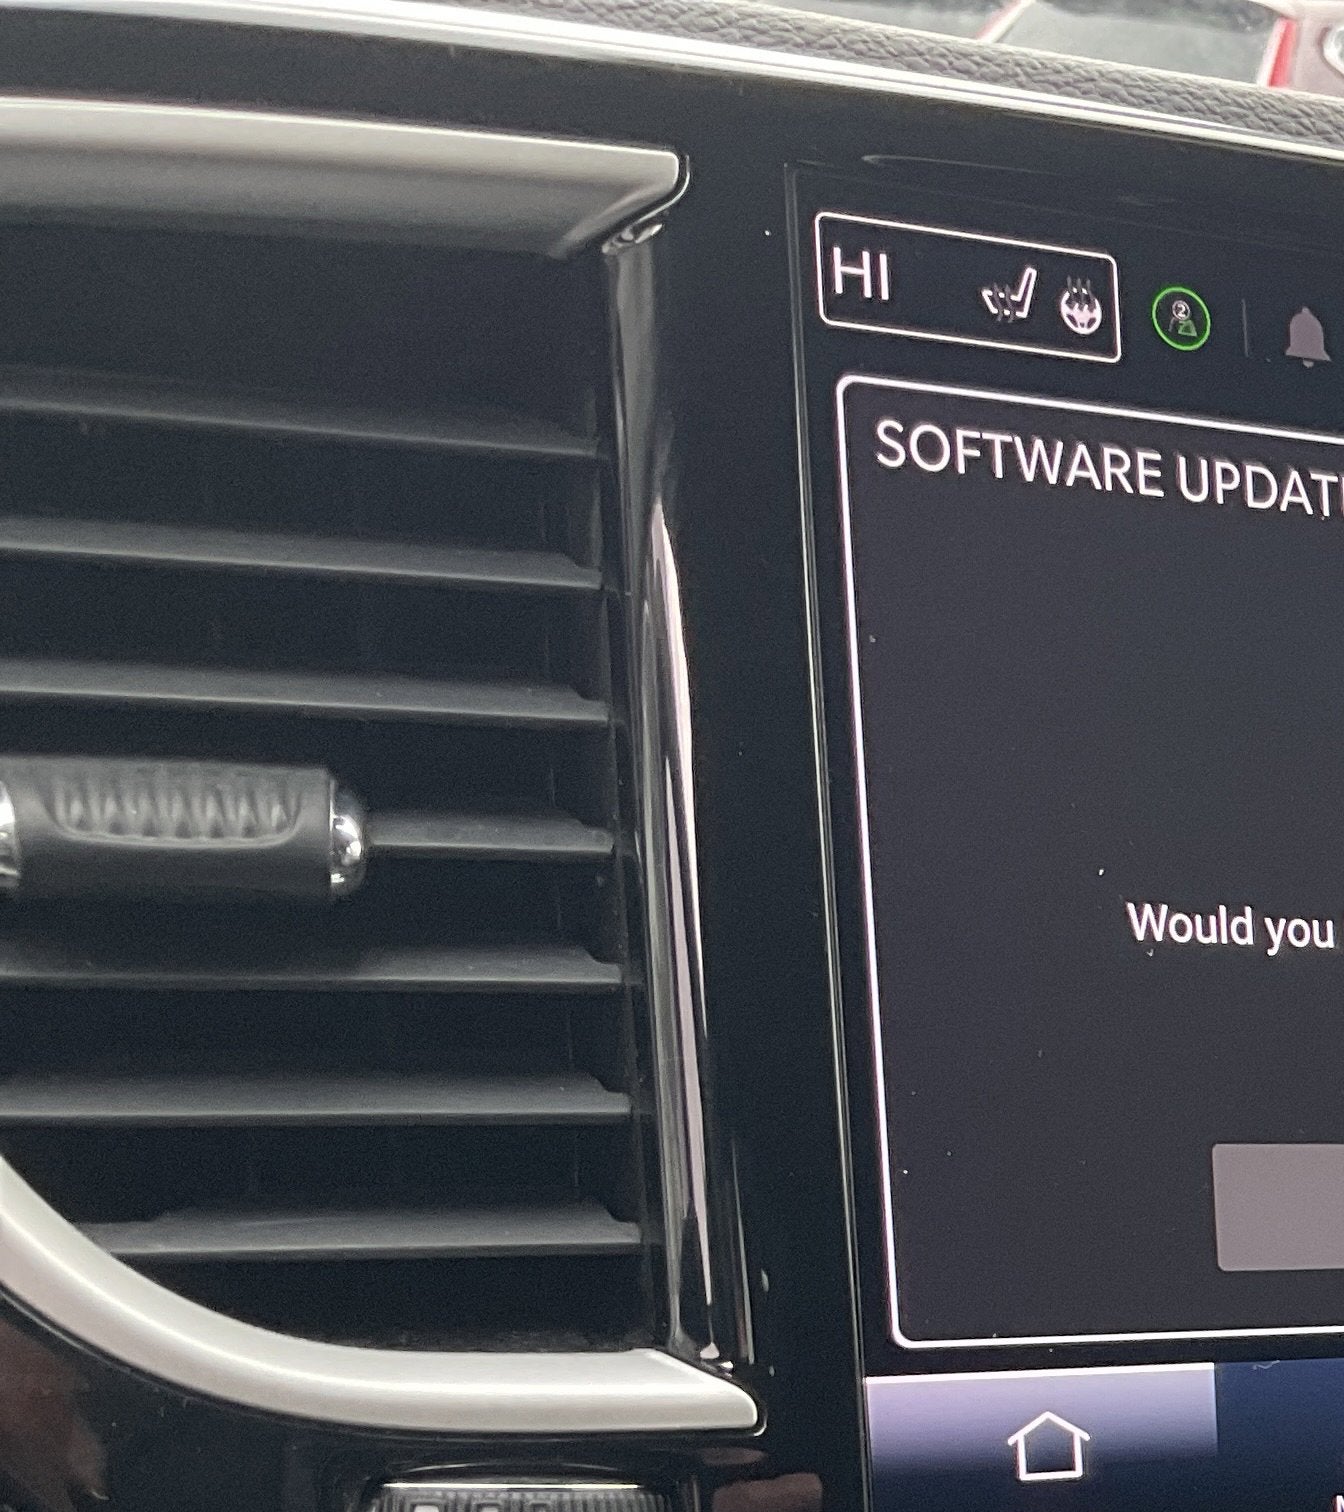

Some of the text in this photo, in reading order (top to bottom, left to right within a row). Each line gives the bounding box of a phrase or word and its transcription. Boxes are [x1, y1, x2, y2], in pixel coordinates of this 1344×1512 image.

[832, 246, 890, 301] HI
[876, 419, 1164, 498] SOFTWARE
[1126, 902, 1254, 946] Would
[1263, 917, 1335, 957] you
